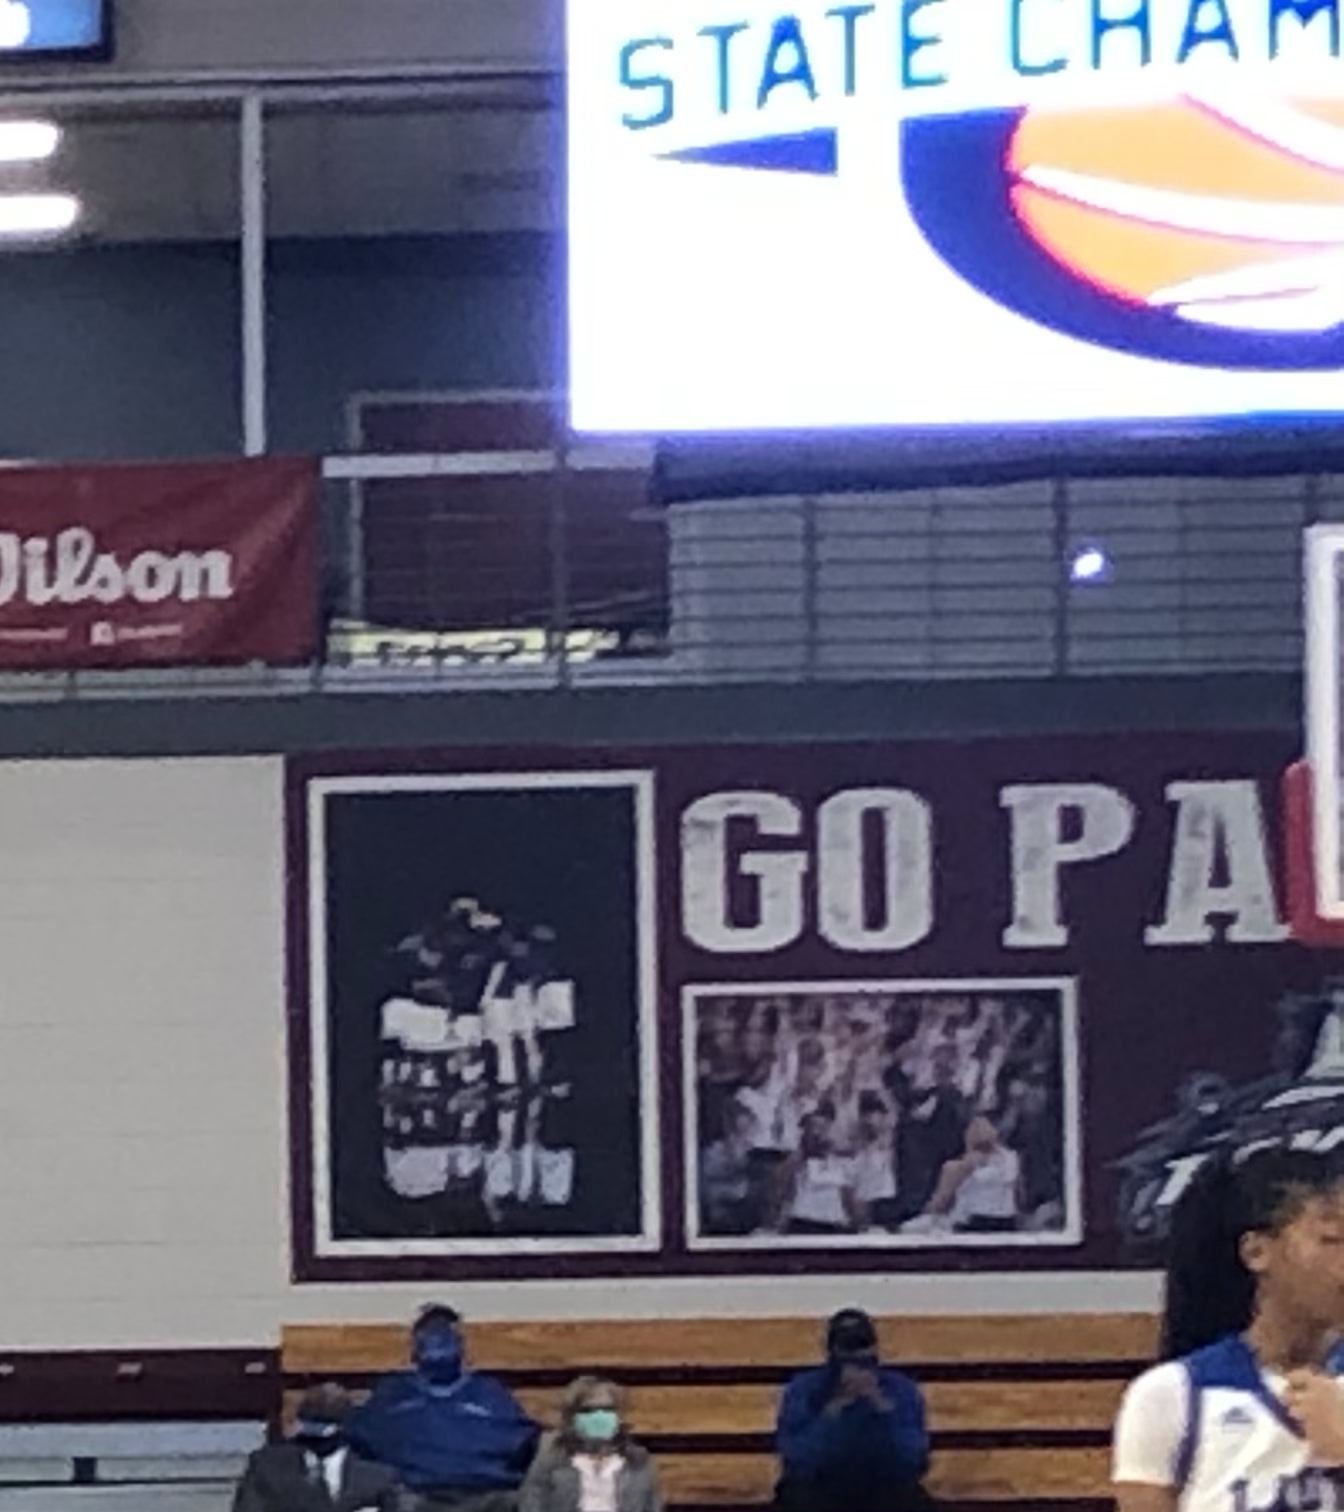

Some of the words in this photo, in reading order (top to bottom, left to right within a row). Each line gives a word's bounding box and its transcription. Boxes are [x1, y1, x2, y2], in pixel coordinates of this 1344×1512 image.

[617, 0, 950, 130] STATE
[680, 788, 933, 952] GO
[999, 779, 1292, 948] PA
